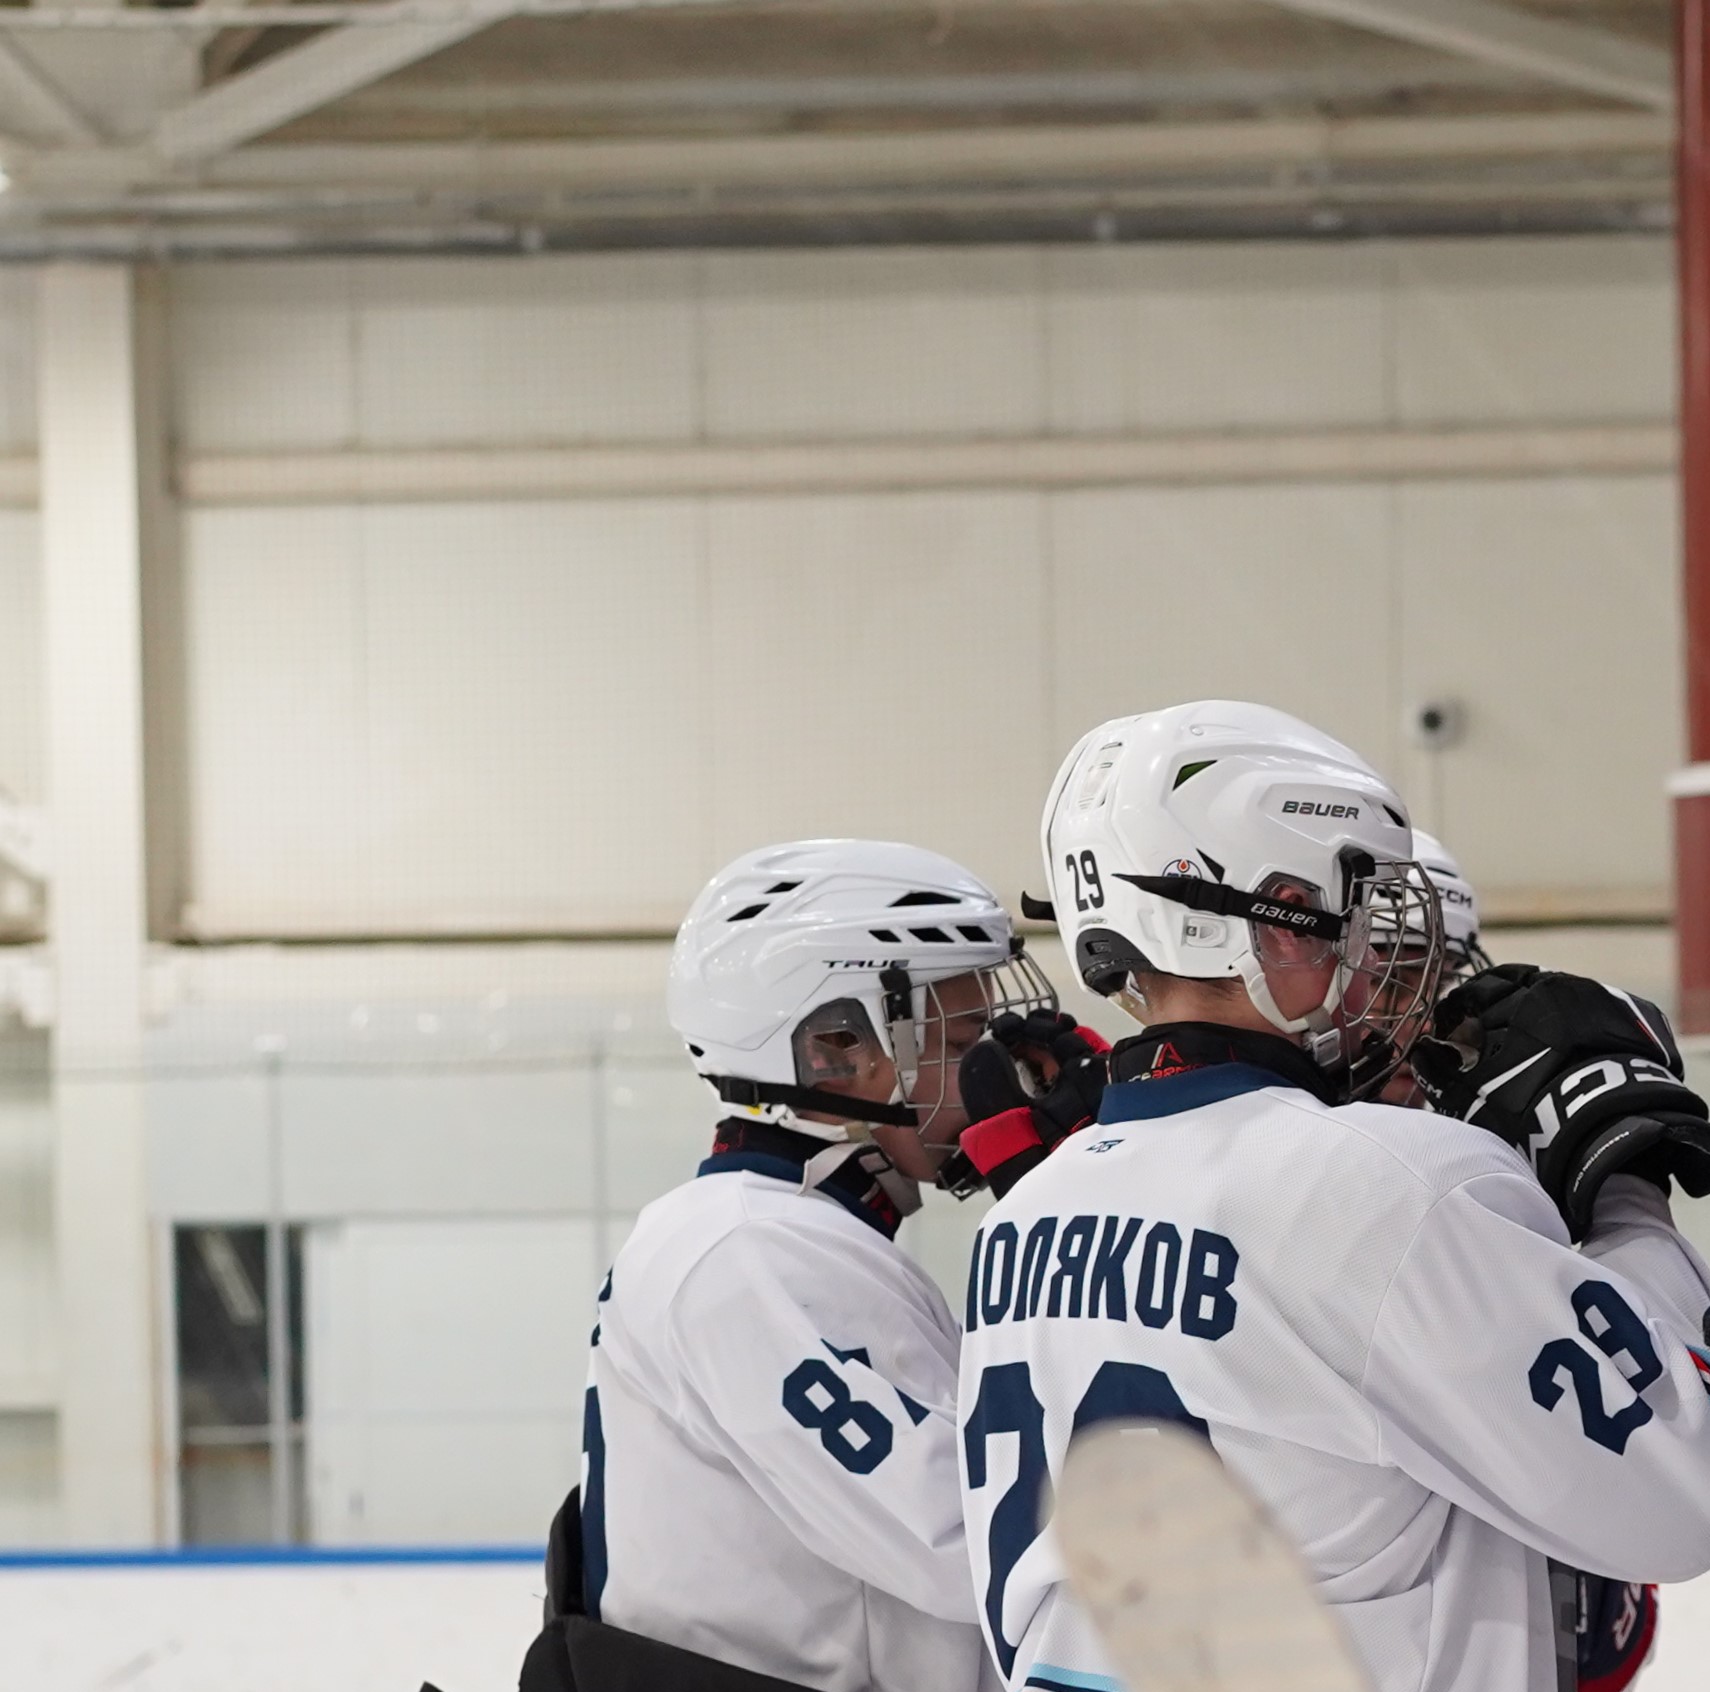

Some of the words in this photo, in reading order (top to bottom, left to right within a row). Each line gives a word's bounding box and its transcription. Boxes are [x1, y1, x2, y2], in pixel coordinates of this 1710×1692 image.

[1281, 800, 1360, 820] BAUER
[1066, 850, 1105, 913] 29
[1250, 903, 1318, 928] BAUER
[822, 959, 911, 969] TRUE
[1528, 1279, 1664, 1457] 29
